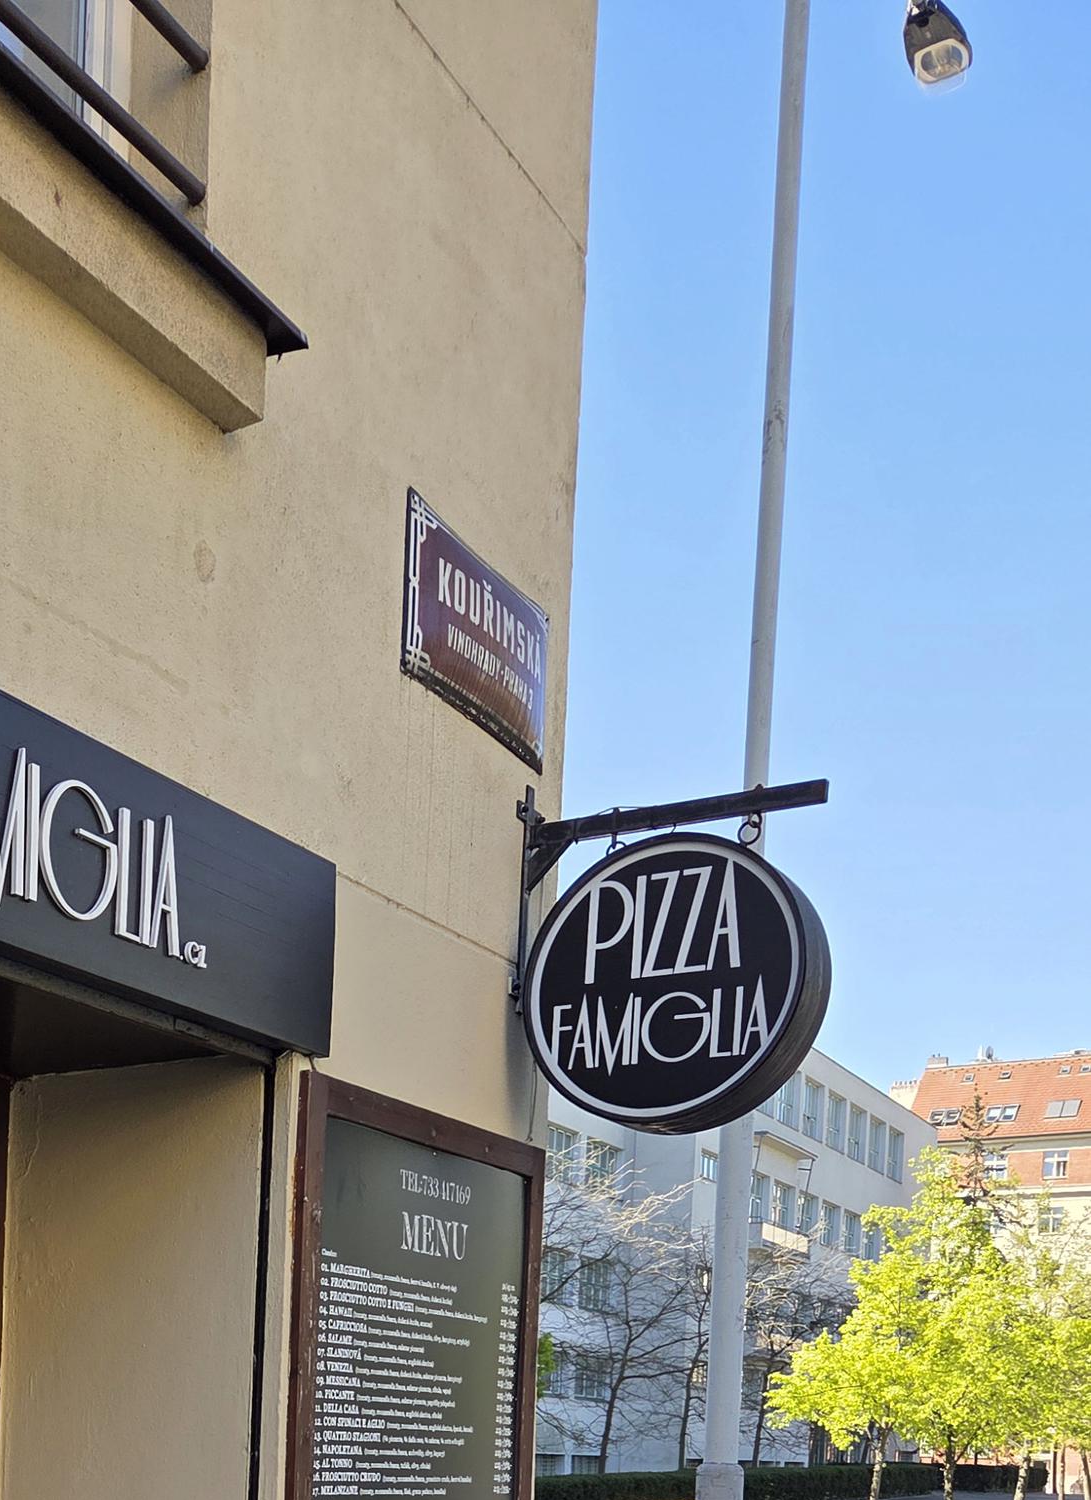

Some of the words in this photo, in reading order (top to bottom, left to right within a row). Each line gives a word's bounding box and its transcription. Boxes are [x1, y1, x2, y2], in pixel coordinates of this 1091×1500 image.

[438, 557, 541, 683] KOUŘIMSKÁ
[447, 623, 501, 681] VINOHRADY
[503, 666, 527, 705] PRAHA
[527, 689, 533, 711] 3
[584, 865, 741, 985] PIZZA
[551, 974, 769, 1076] FAMIGLIA
[400, 1209, 468, 1262] MENU
